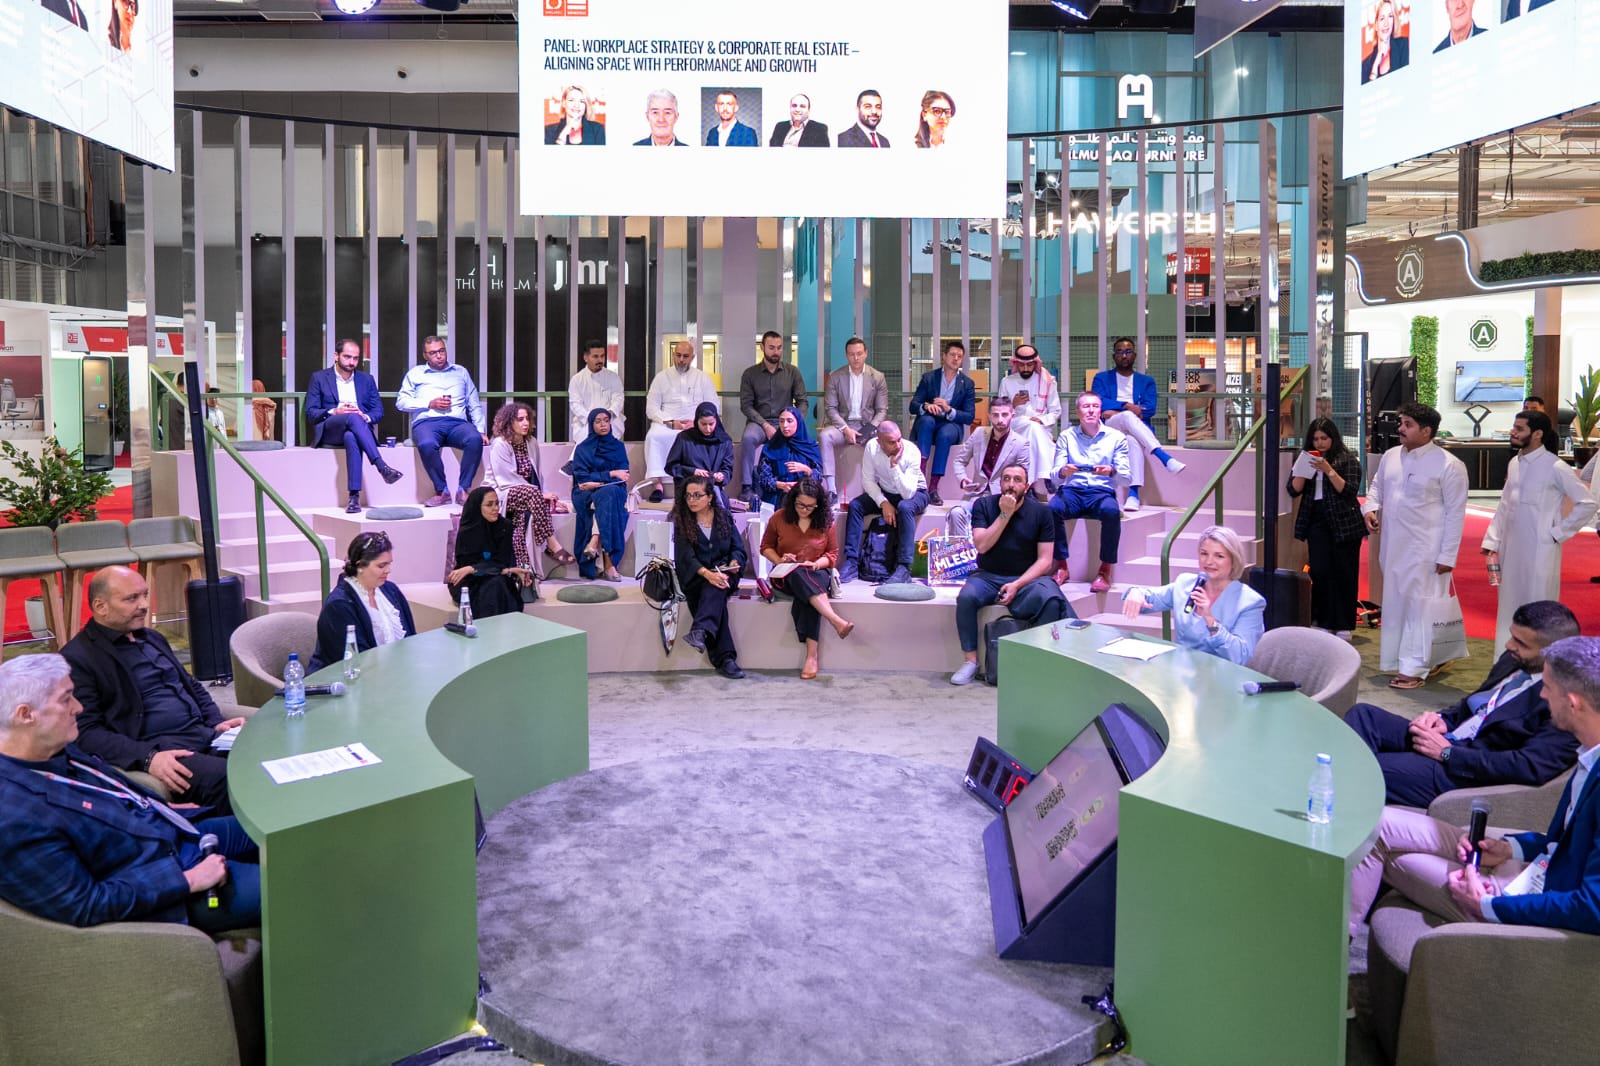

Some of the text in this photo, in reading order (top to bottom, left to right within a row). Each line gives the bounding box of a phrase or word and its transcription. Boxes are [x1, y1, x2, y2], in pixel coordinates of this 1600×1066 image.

[544, 38, 579, 53] PANEL:
[583, 39, 648, 54] WORKPLACE
[651, 40, 703, 54] STRATEGY
[707, 41, 715, 54] &
[718, 41, 781, 55] CORPORATE
[784, 42, 810, 55] REAL
[813, 42, 848, 55] ESTATE
[544, 56, 817, 73] ALIGNING SPACE WITH PERFORMANCE AND GROWTH
